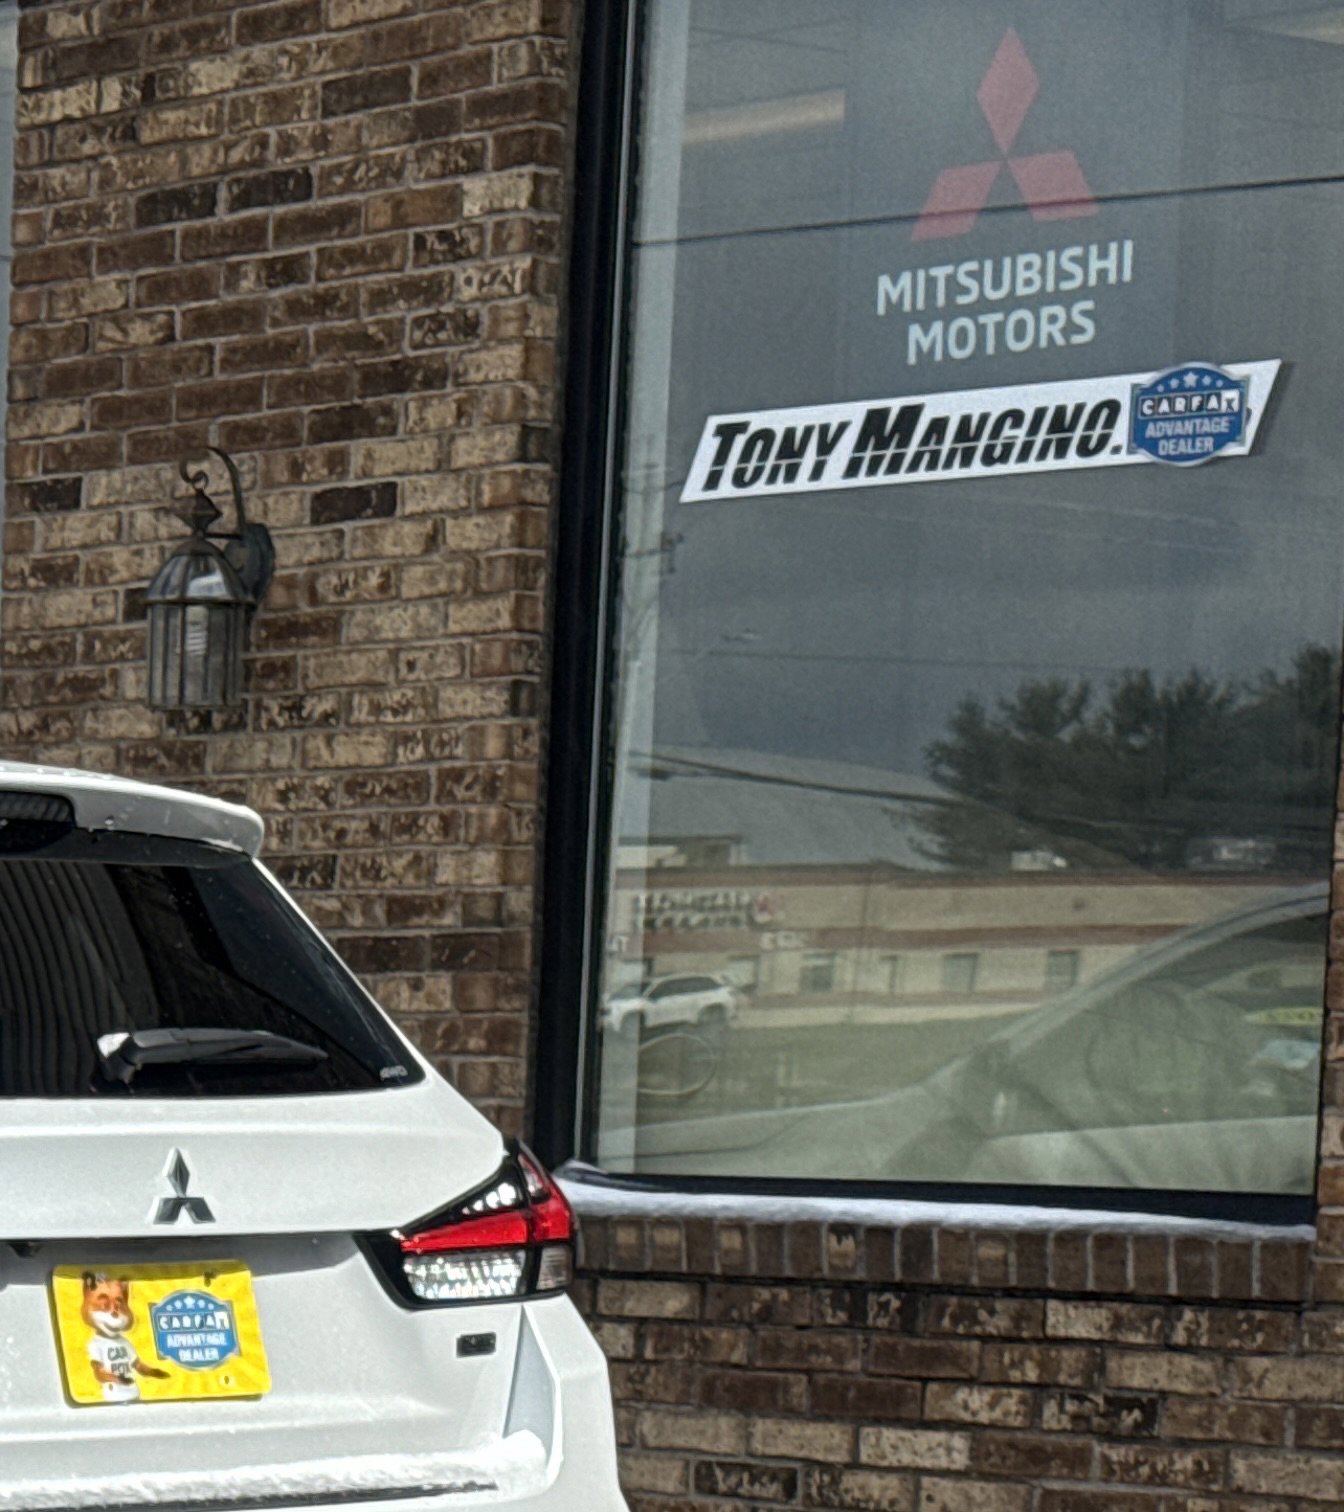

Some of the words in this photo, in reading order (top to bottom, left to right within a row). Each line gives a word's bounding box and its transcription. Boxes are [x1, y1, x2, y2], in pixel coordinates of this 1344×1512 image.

[876, 239, 1134, 316] MITSUBISHI
[906, 300, 1096, 365] MOTORS
[1142, 389, 1240, 416] CARFAX
[1145, 416, 1230, 438] ADVANTAGE
[1158, 436, 1214, 456] DEALER
